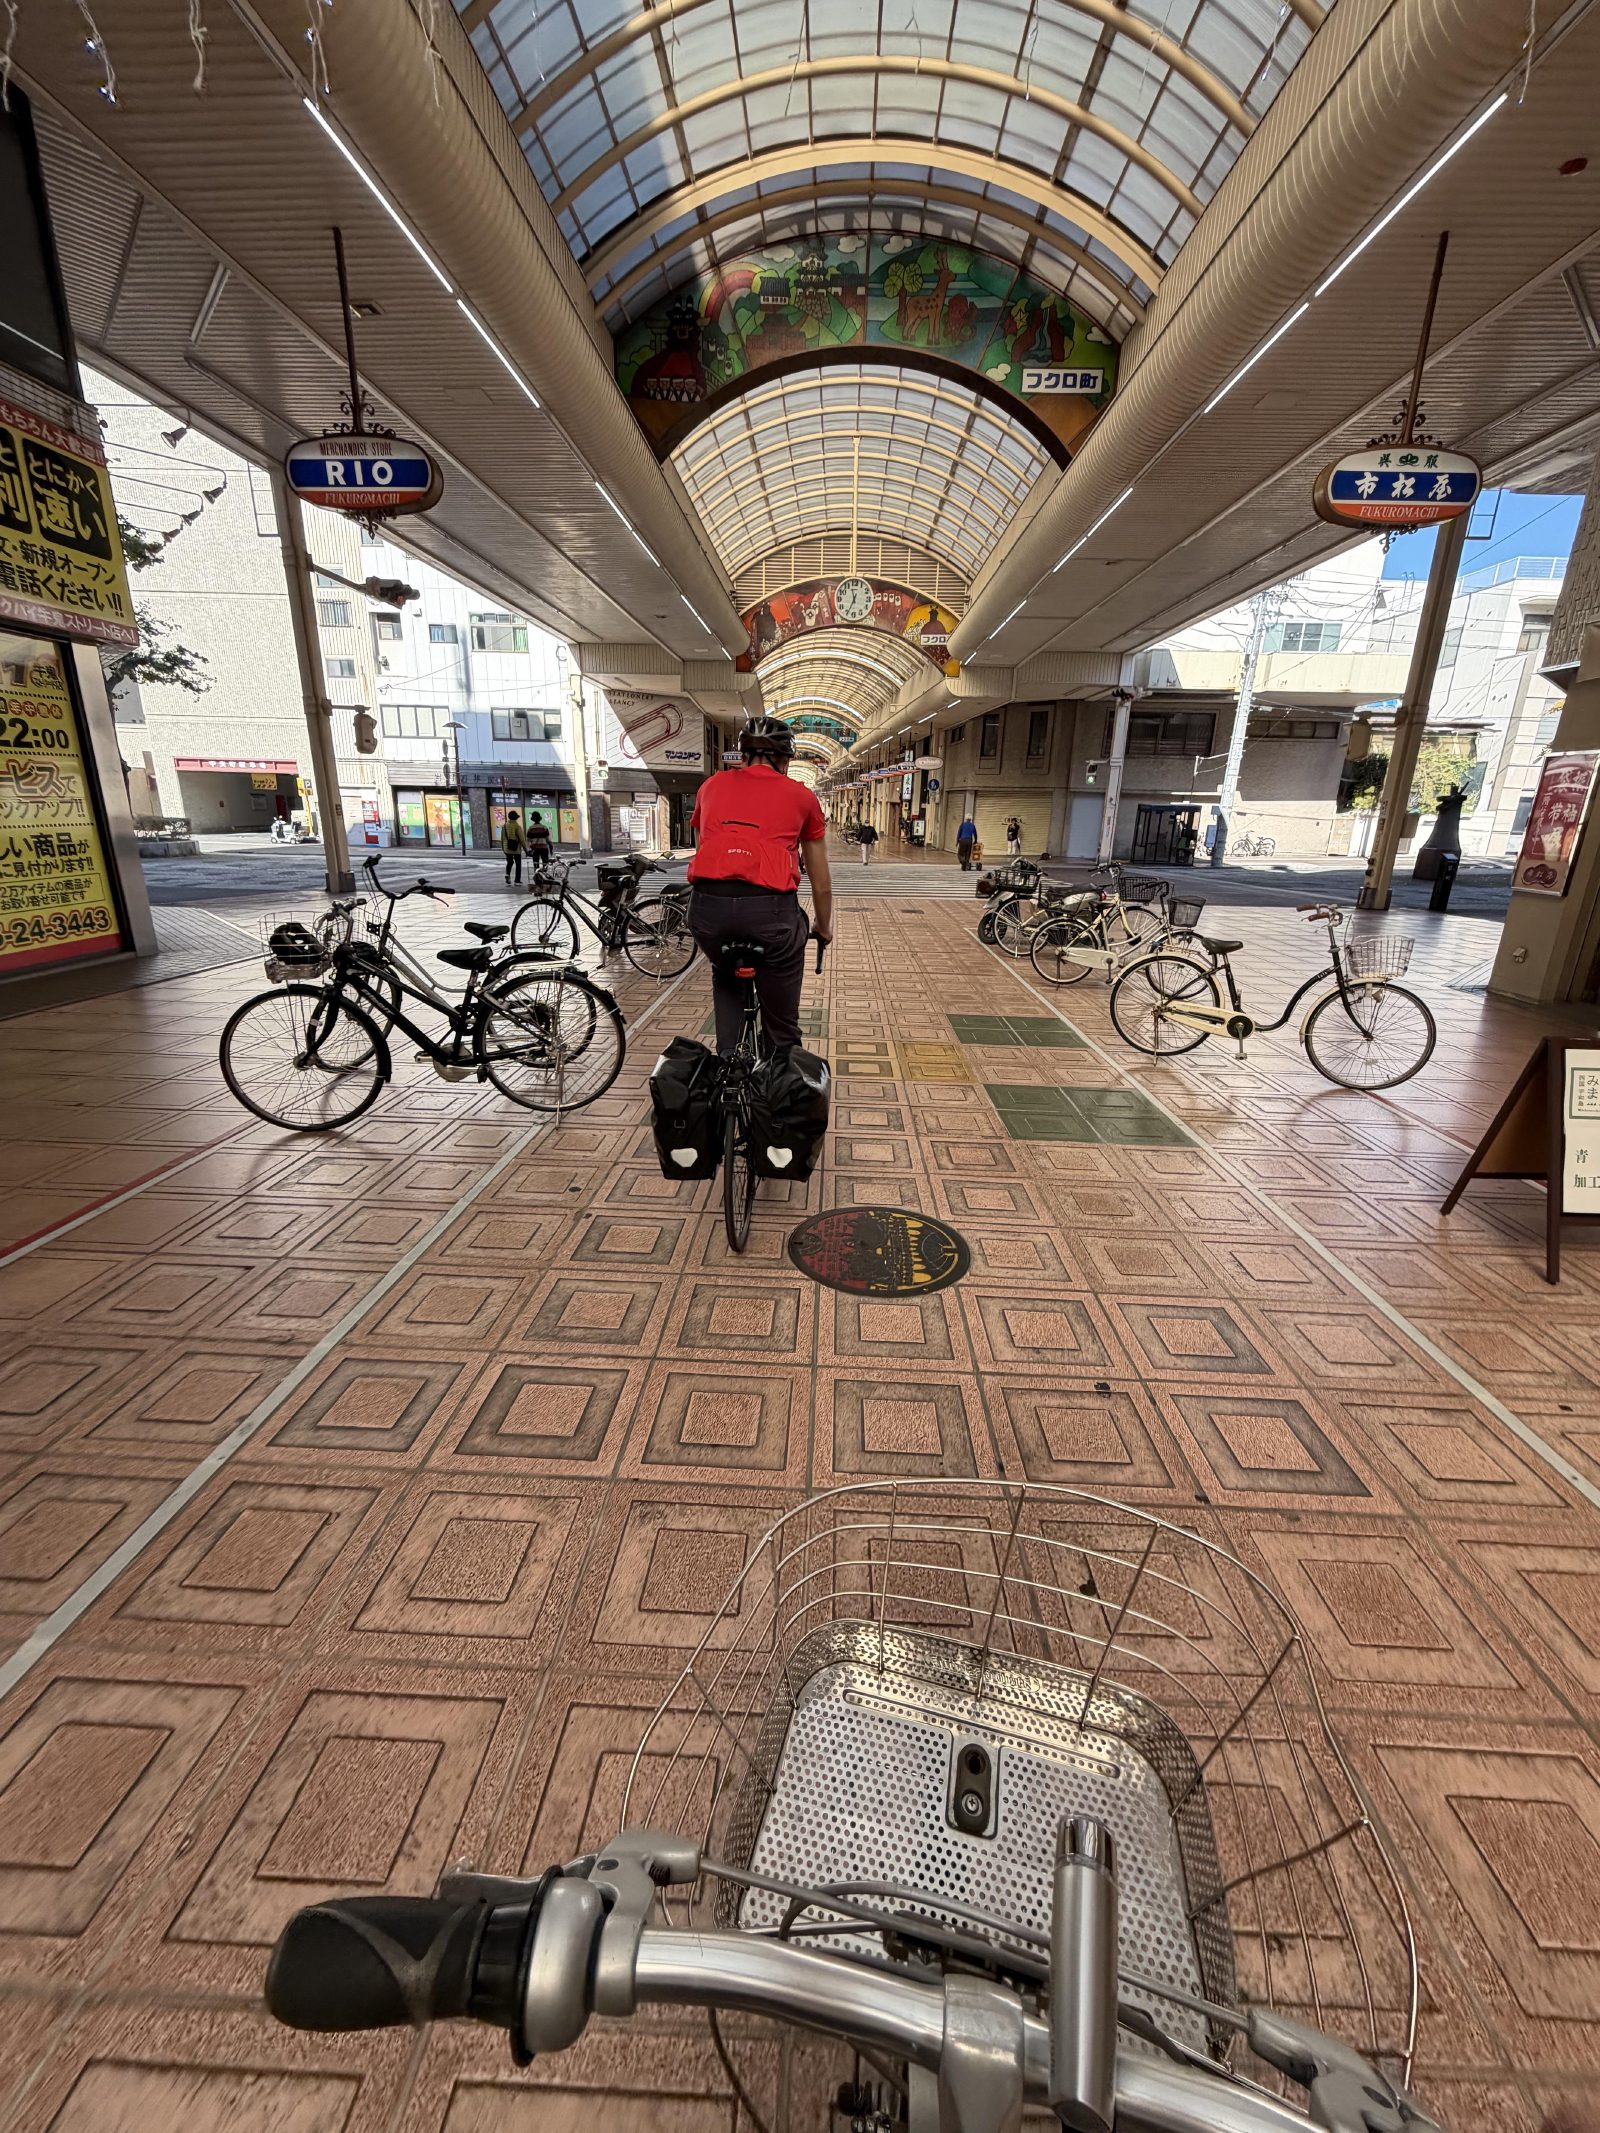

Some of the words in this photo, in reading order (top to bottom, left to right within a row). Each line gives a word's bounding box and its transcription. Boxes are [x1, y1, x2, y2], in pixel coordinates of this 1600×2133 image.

[1026, 373, 1098, 389] フクロ町
[319, 442, 368, 456] MERCHANDISE
[371, 443, 393, 455] STORE
[28, 451, 99, 501] とにかく
[325, 461, 394, 486] RIO
[1355, 472, 1452, 500] 市松屋
[33, 481, 107, 541] 速い
[325, 493, 400, 504] FUKUROMACHI
[1359, 506, 1440, 518] FUKUROMACHI
[0, 908, 110, 946] -24-3443
